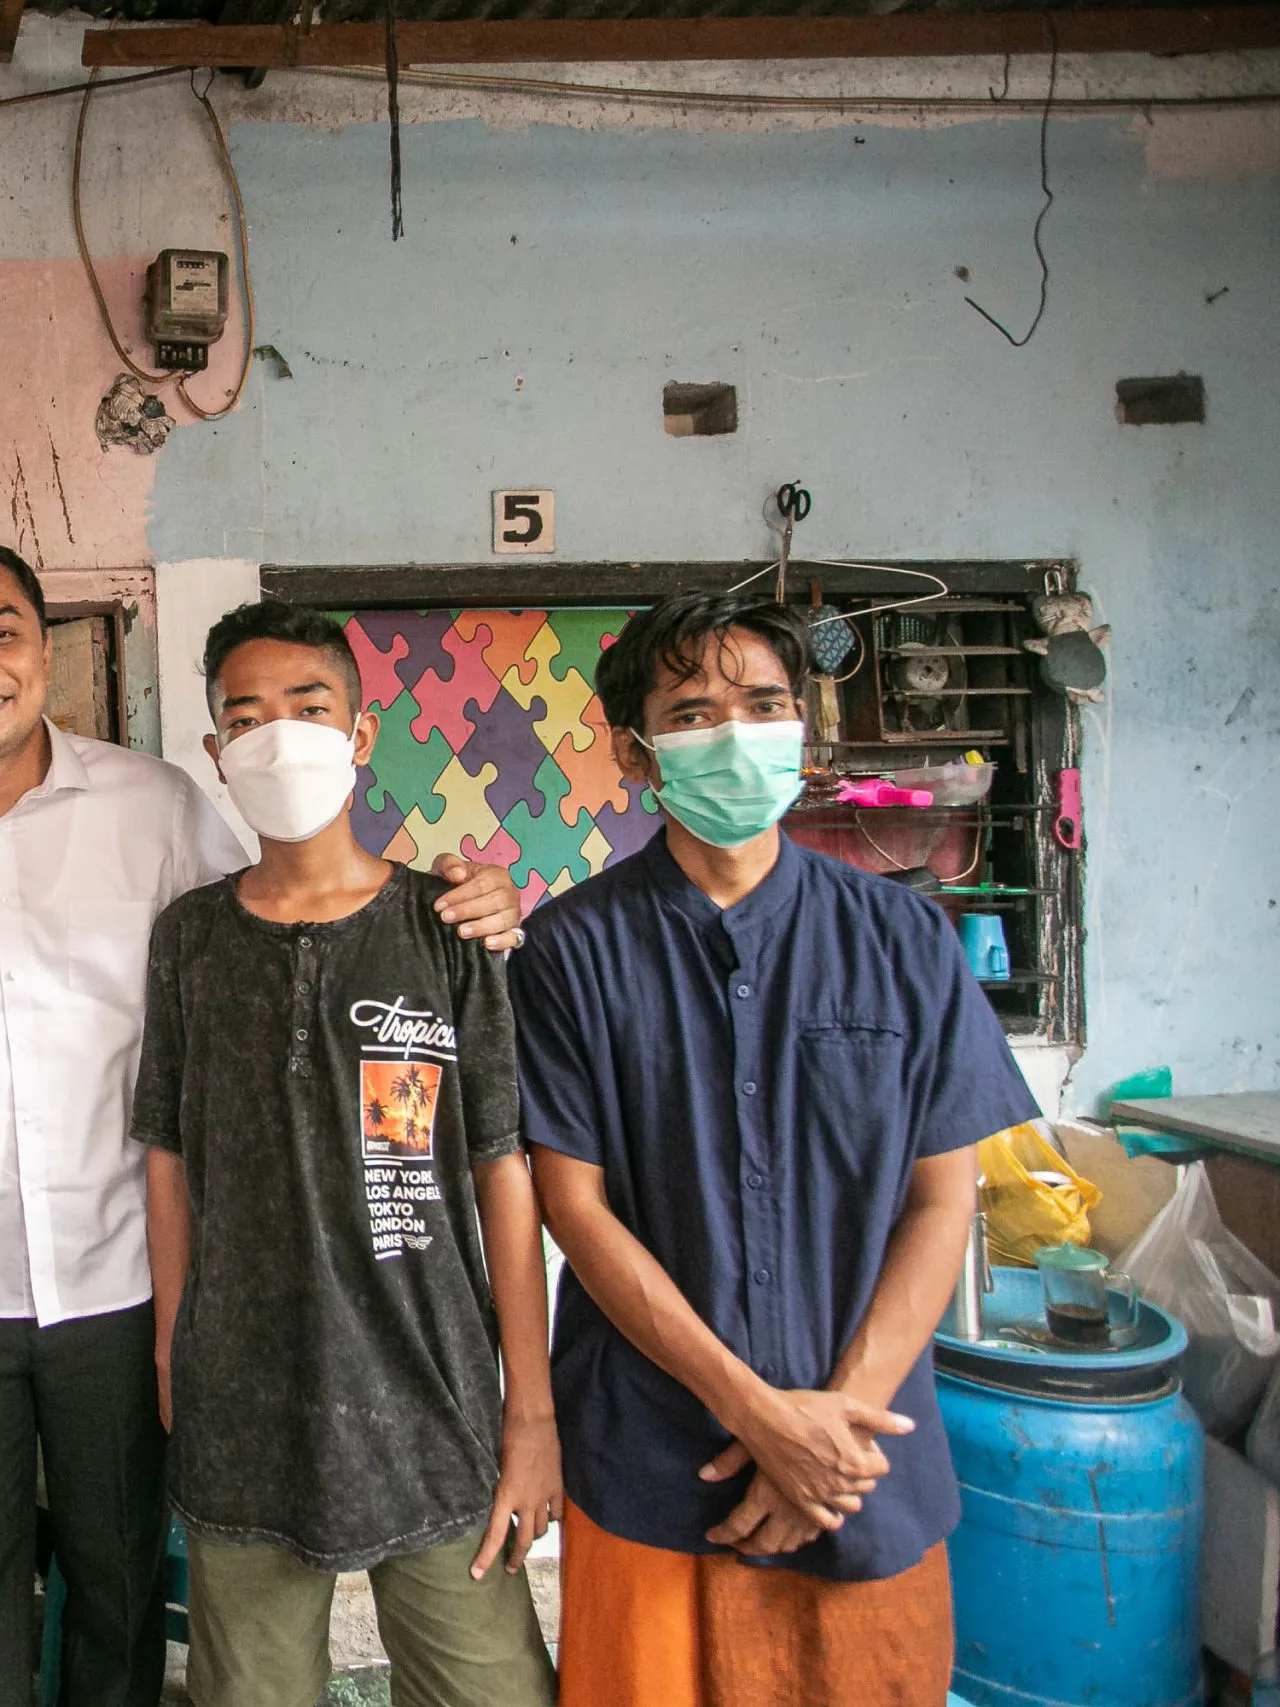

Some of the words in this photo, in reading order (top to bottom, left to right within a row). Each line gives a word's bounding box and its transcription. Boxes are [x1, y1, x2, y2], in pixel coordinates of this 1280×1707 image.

[503, 495, 543, 543] 5
[364, 1168, 397, 1184] NEW
[400, 1170, 434, 1185] YORK
[365, 1185, 390, 1200] LOS
[367, 1202, 414, 1217] TOKYO
[369, 1218, 425, 1234] LONDON
[373, 1233, 402, 1251] PARIS
